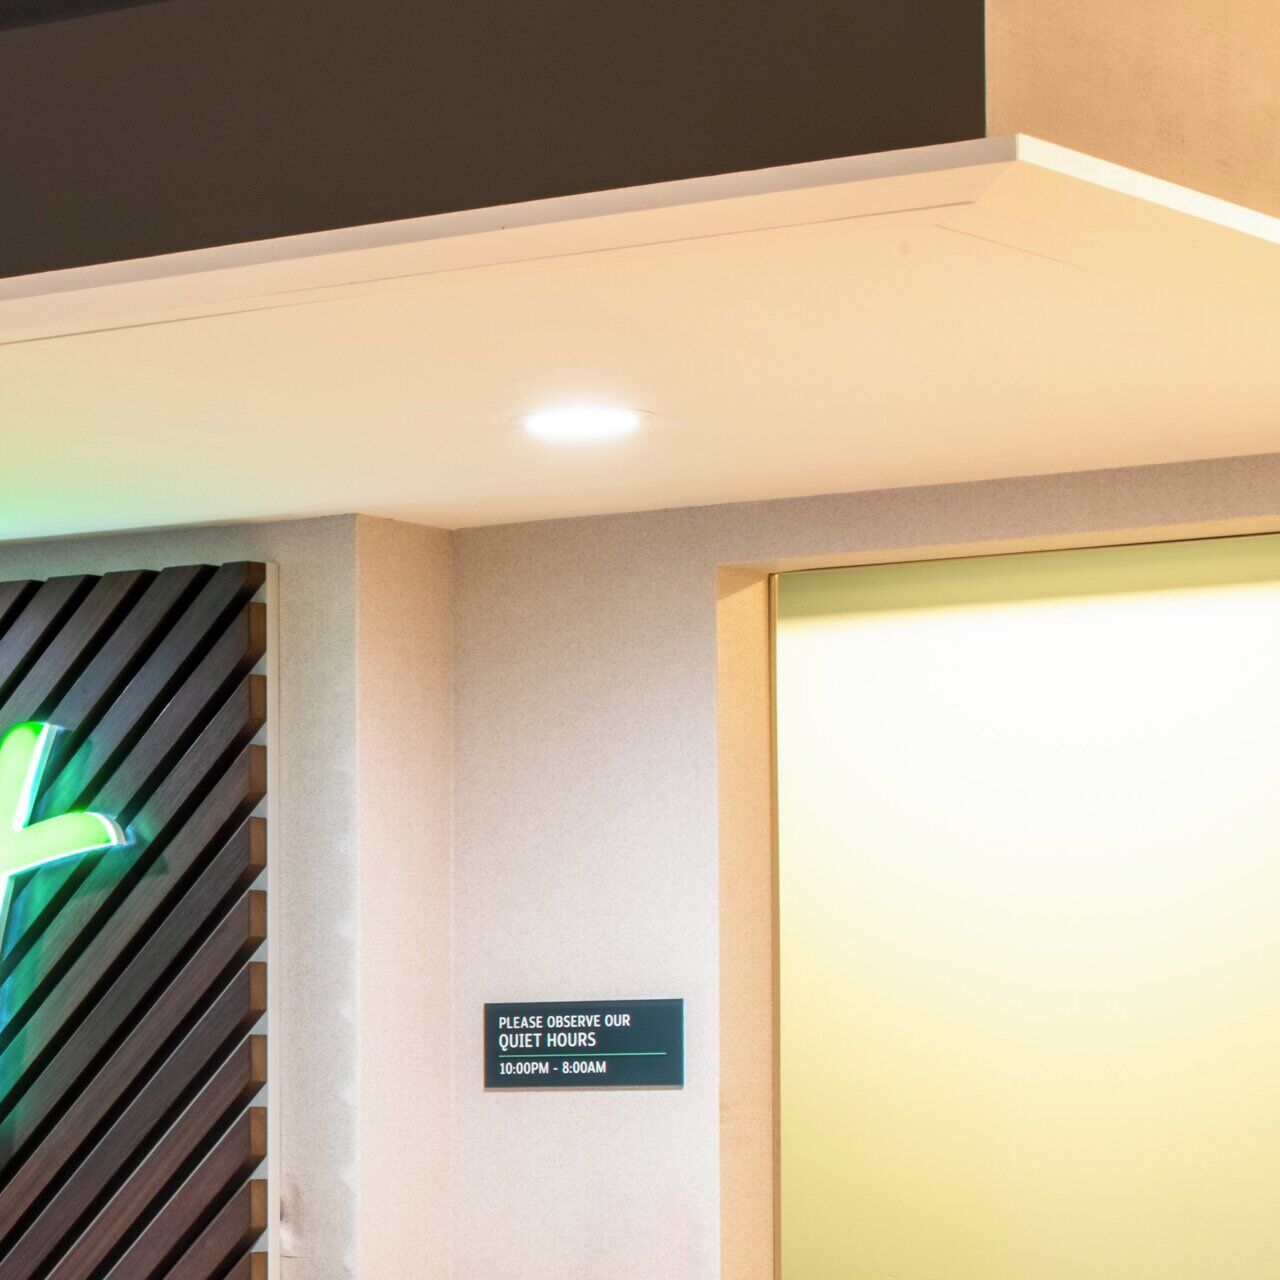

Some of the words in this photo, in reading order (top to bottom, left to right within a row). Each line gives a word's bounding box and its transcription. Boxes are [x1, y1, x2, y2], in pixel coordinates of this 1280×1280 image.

[498, 1016, 543, 1029] PLEASE
[547, 1015, 601, 1028] OBSERVE
[605, 1014, 631, 1027] OUR
[498, 1033, 542, 1051] QUIET
[547, 1032, 596, 1047] HOURS
[499, 1062, 549, 1075] 10:00PM
[562, 1061, 606, 1074] 8:00AM
